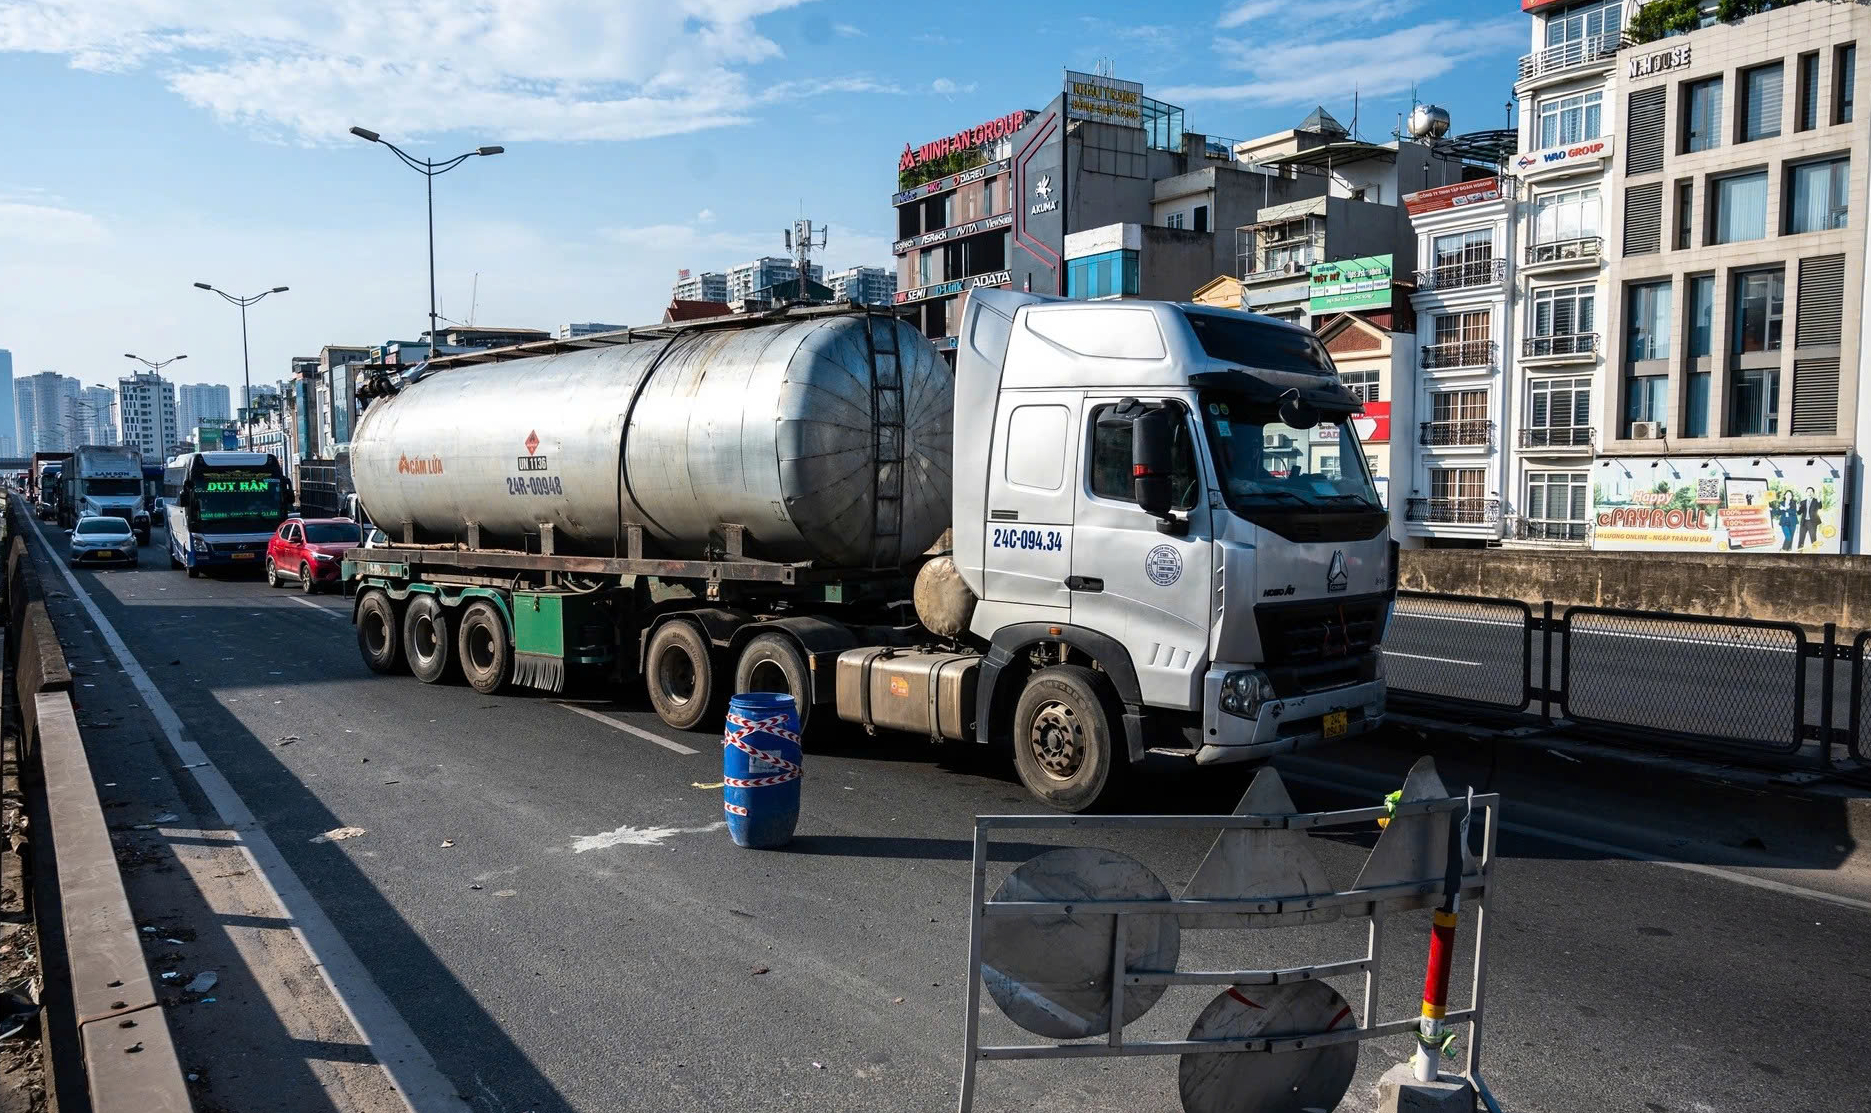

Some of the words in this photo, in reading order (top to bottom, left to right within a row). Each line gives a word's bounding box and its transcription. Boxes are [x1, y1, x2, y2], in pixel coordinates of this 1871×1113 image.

[1628, 47, 1691, 78] N.HOUSE
[919, 137, 950, 164] MINH
[953, 129, 971, 151] AN
[974, 110, 1024, 144] GROUP
[1543, 150, 1567, 163] WAO
[1568, 142, 1604, 158] GROUP
[921, 230, 947, 245] ASRock
[972, 271, 1011, 287] ADATA
[935, 281, 964, 296] D-Link
[519, 457, 529, 470] UN
[207, 482, 236, 491] DUY
[240, 480, 269, 491] HÂN
[506, 476, 562, 495] 24R-00948
[1632, 490, 1675, 505] Happy
[1597, 507, 1709, 530] ePAYROLL
[993, 528, 1062, 551] 24C-094.34
